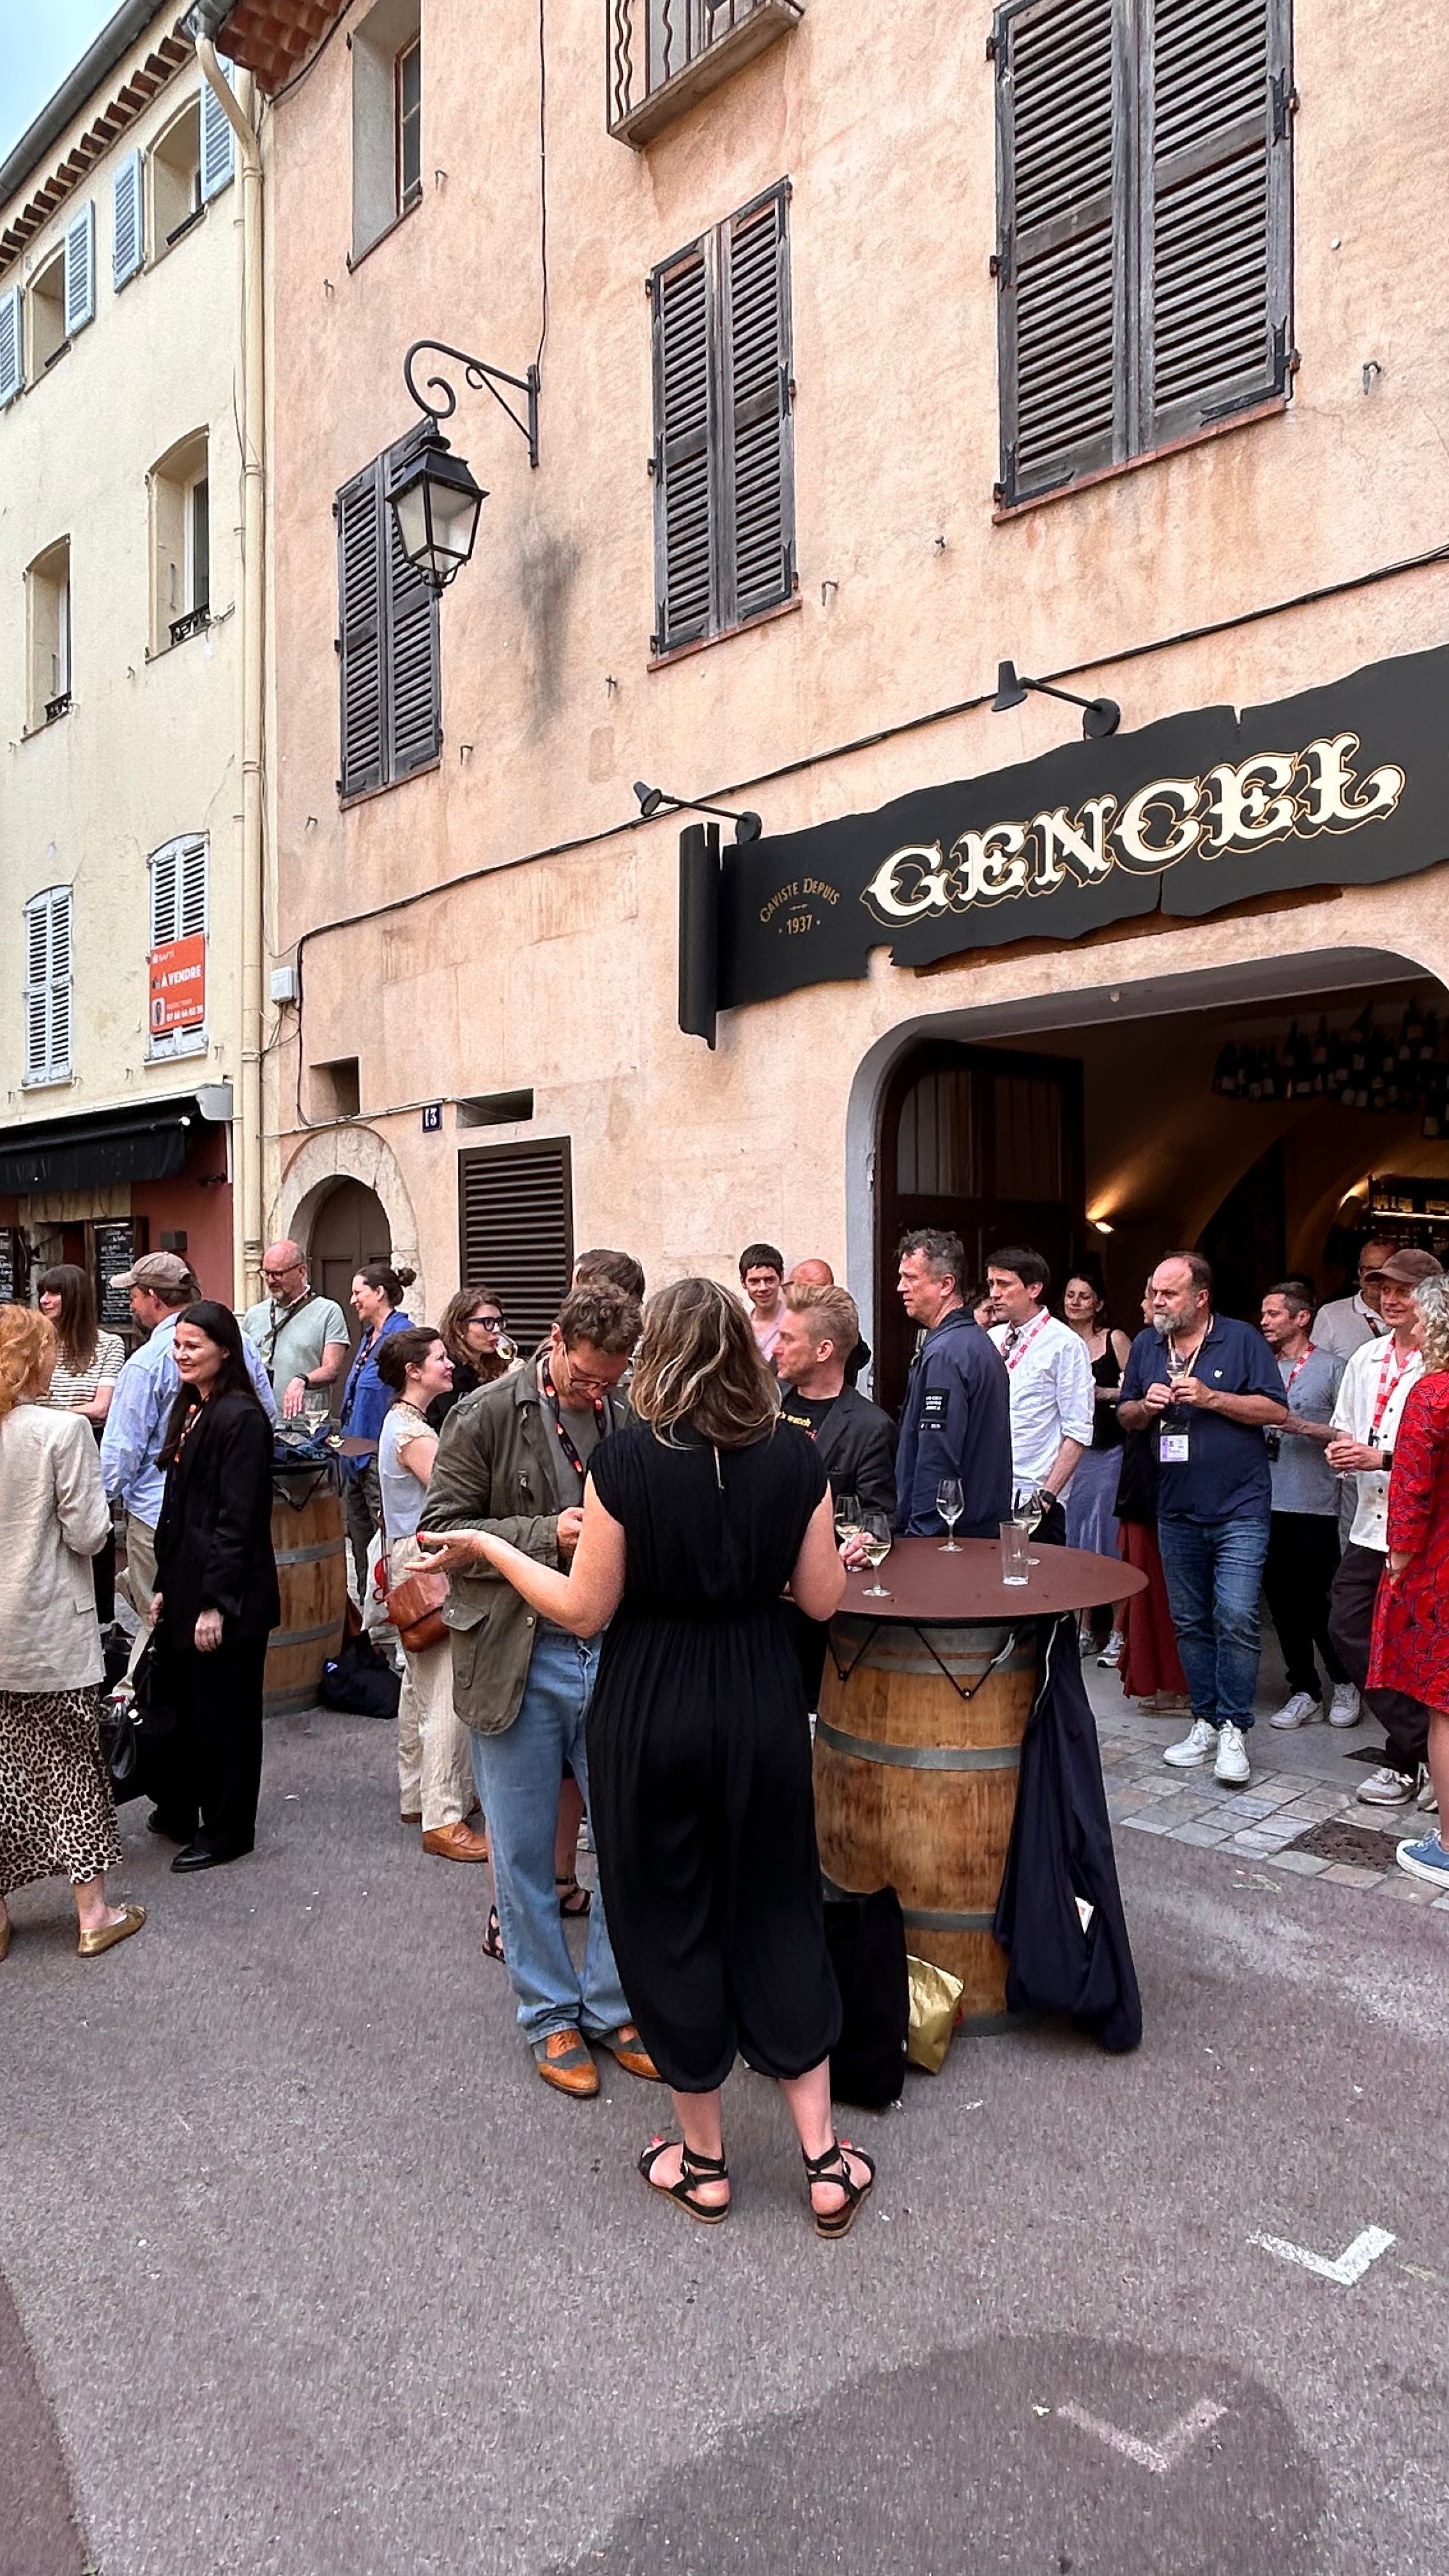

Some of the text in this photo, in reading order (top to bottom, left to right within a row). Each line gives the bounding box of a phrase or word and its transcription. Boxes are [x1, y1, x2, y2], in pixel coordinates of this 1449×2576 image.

[862, 732, 1405, 922] GENCEL
[759, 877, 841, 923] CAVISTE DEPUIS
[786, 914, 813, 935] 1937
[167, 964, 202, 985] VENDRE
[424, 1108, 437, 1127] 13
